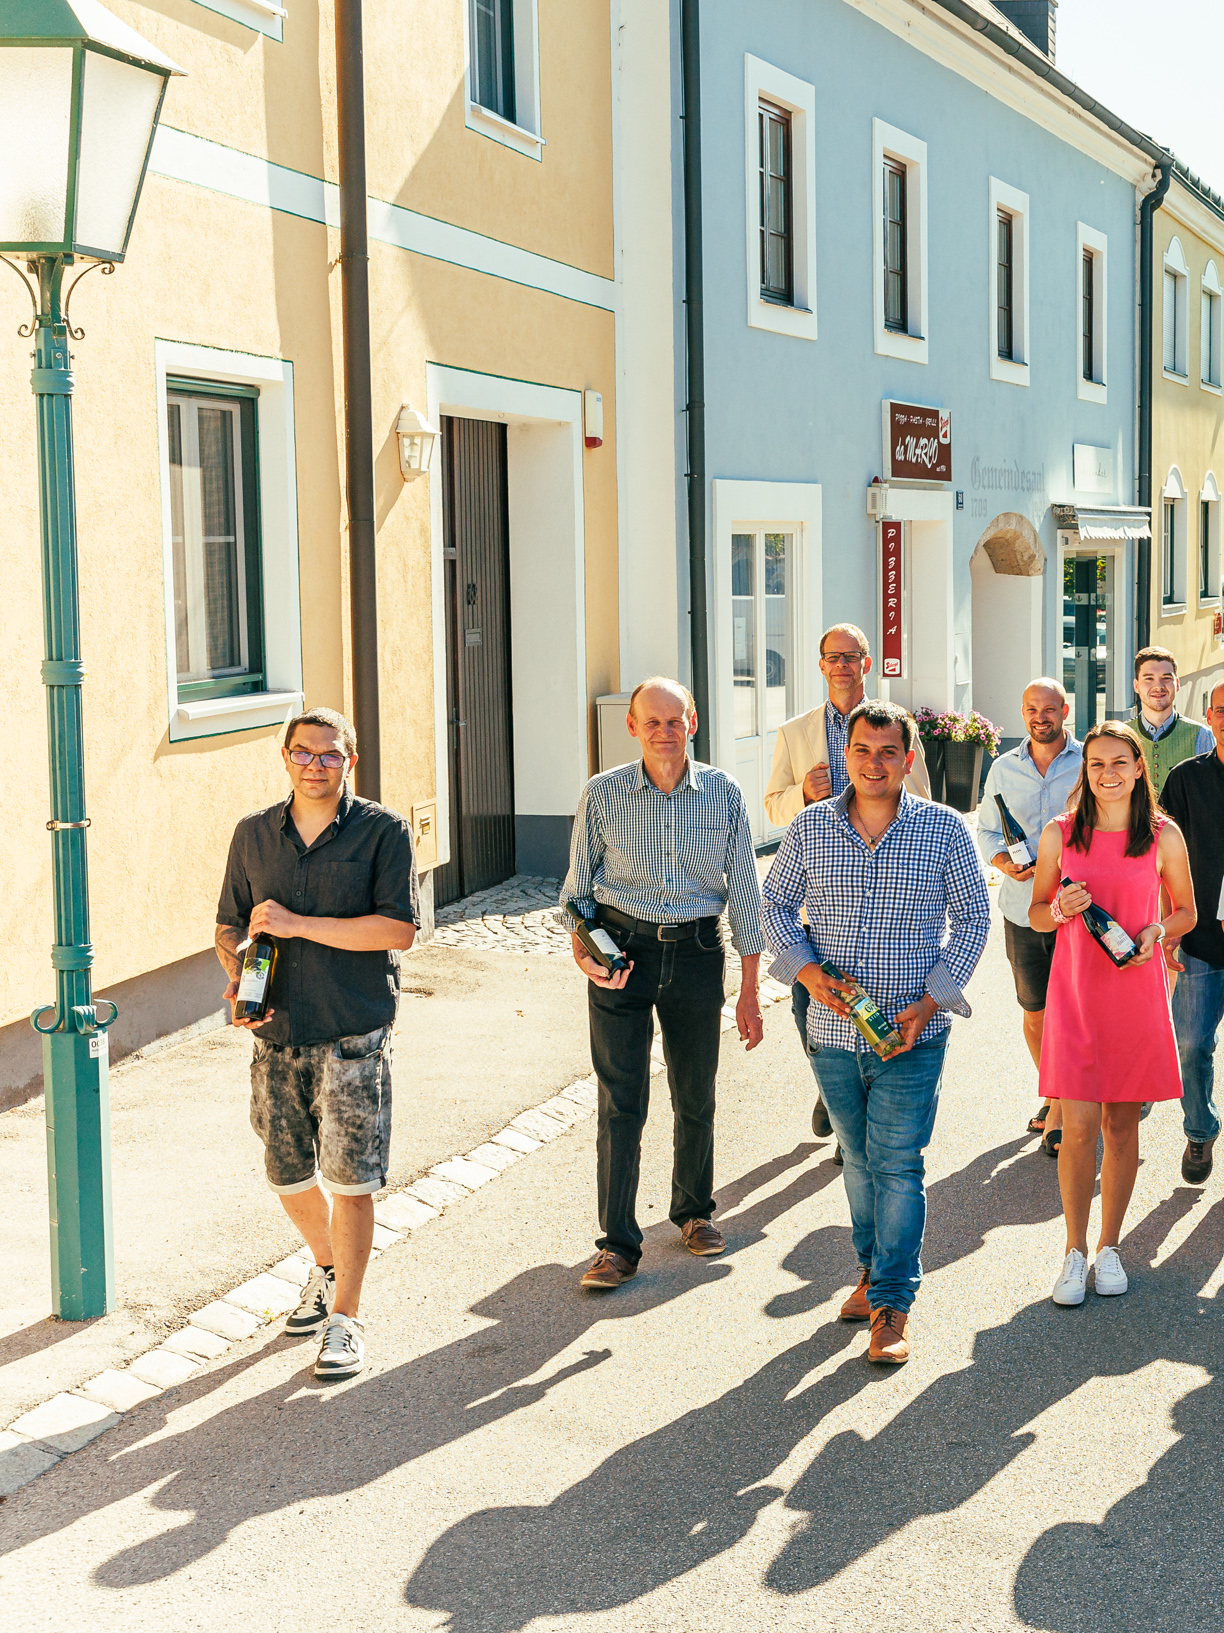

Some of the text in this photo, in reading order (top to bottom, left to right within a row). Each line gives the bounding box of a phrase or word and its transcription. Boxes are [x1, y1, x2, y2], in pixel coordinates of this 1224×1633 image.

[895, 434, 938, 469] da MARCO
[970, 455, 1046, 493] Gemeindesaal
[887, 529, 898, 635] PIZZERIA
